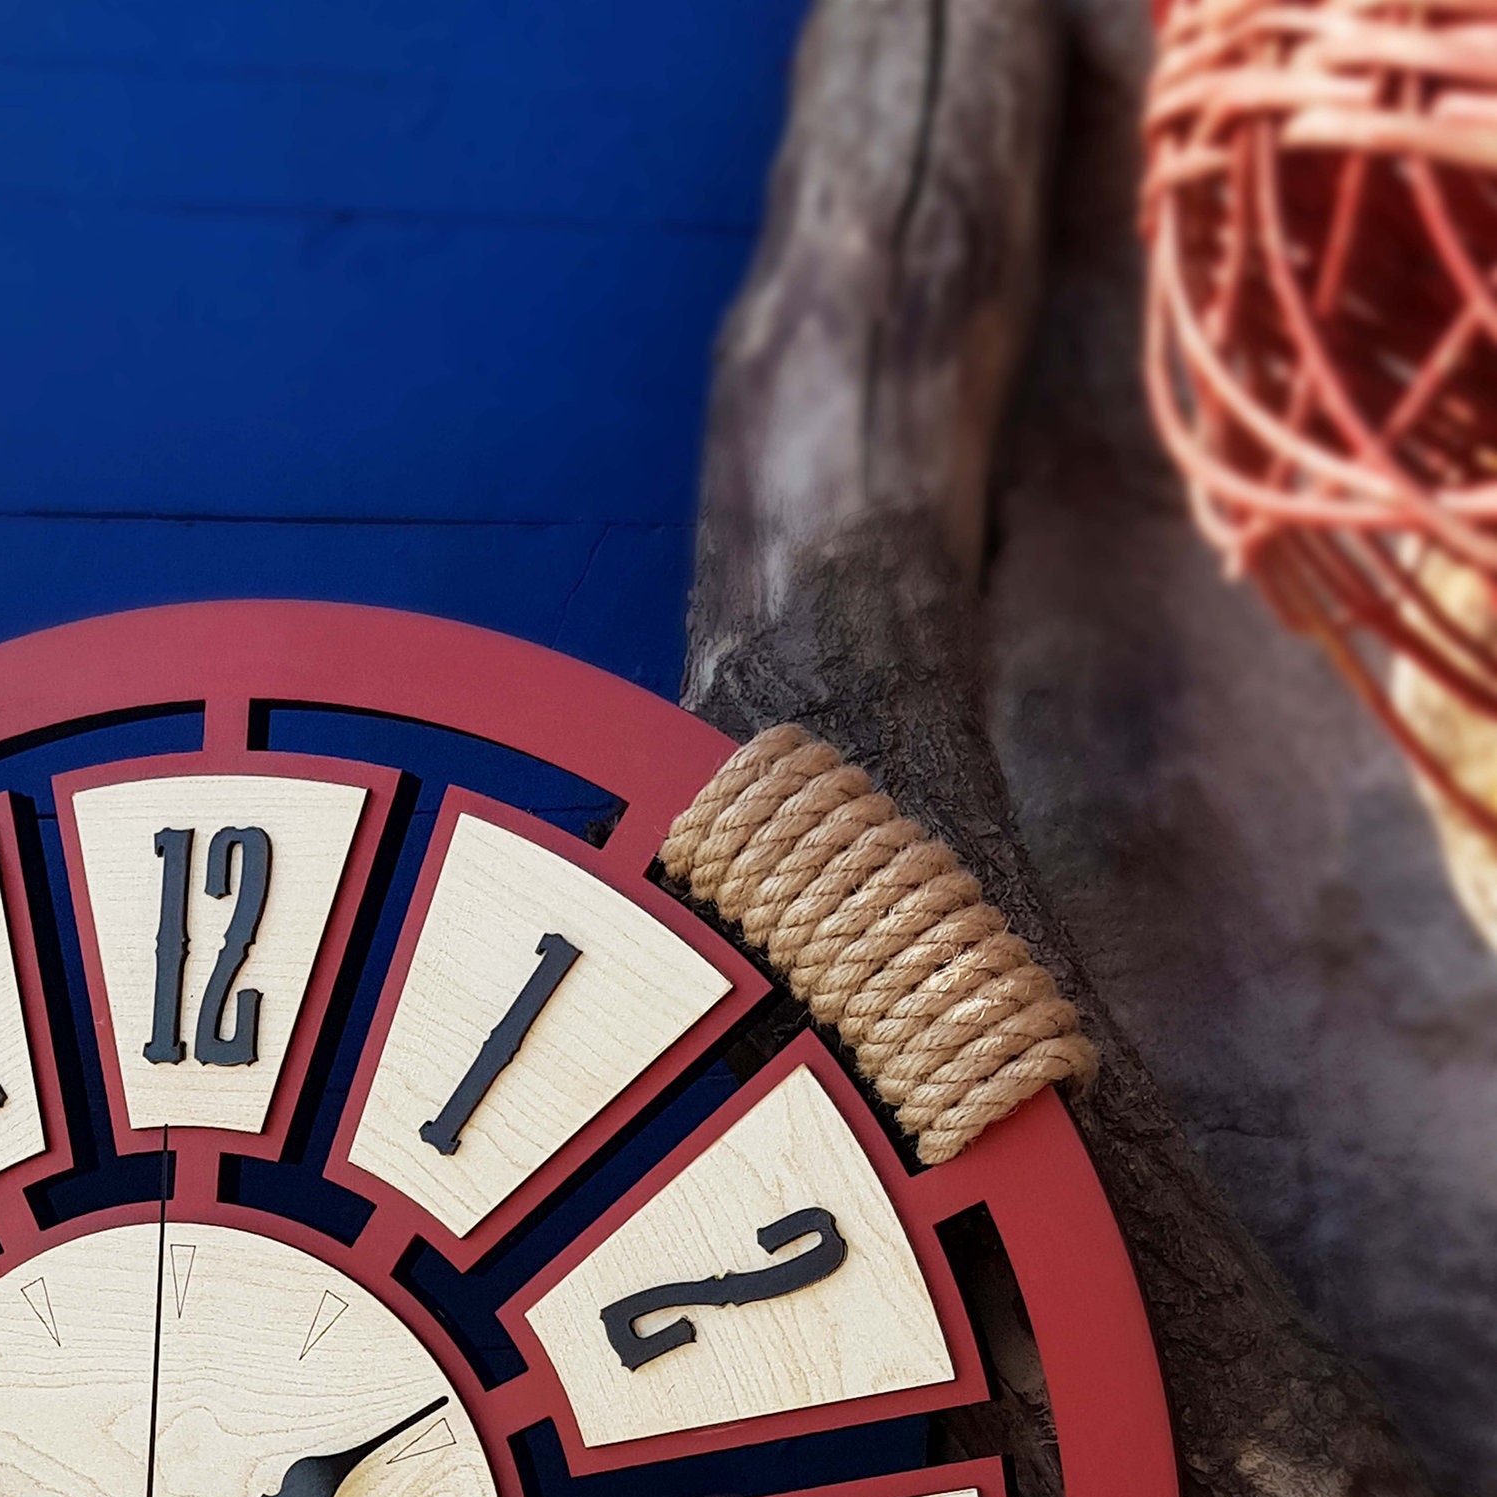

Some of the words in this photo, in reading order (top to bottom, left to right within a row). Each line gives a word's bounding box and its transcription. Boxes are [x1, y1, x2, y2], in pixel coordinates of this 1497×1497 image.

[142, 826, 274, 1068] 12
[419, 932, 583, 1156] 1
[600, 1206, 849, 1372] 2
